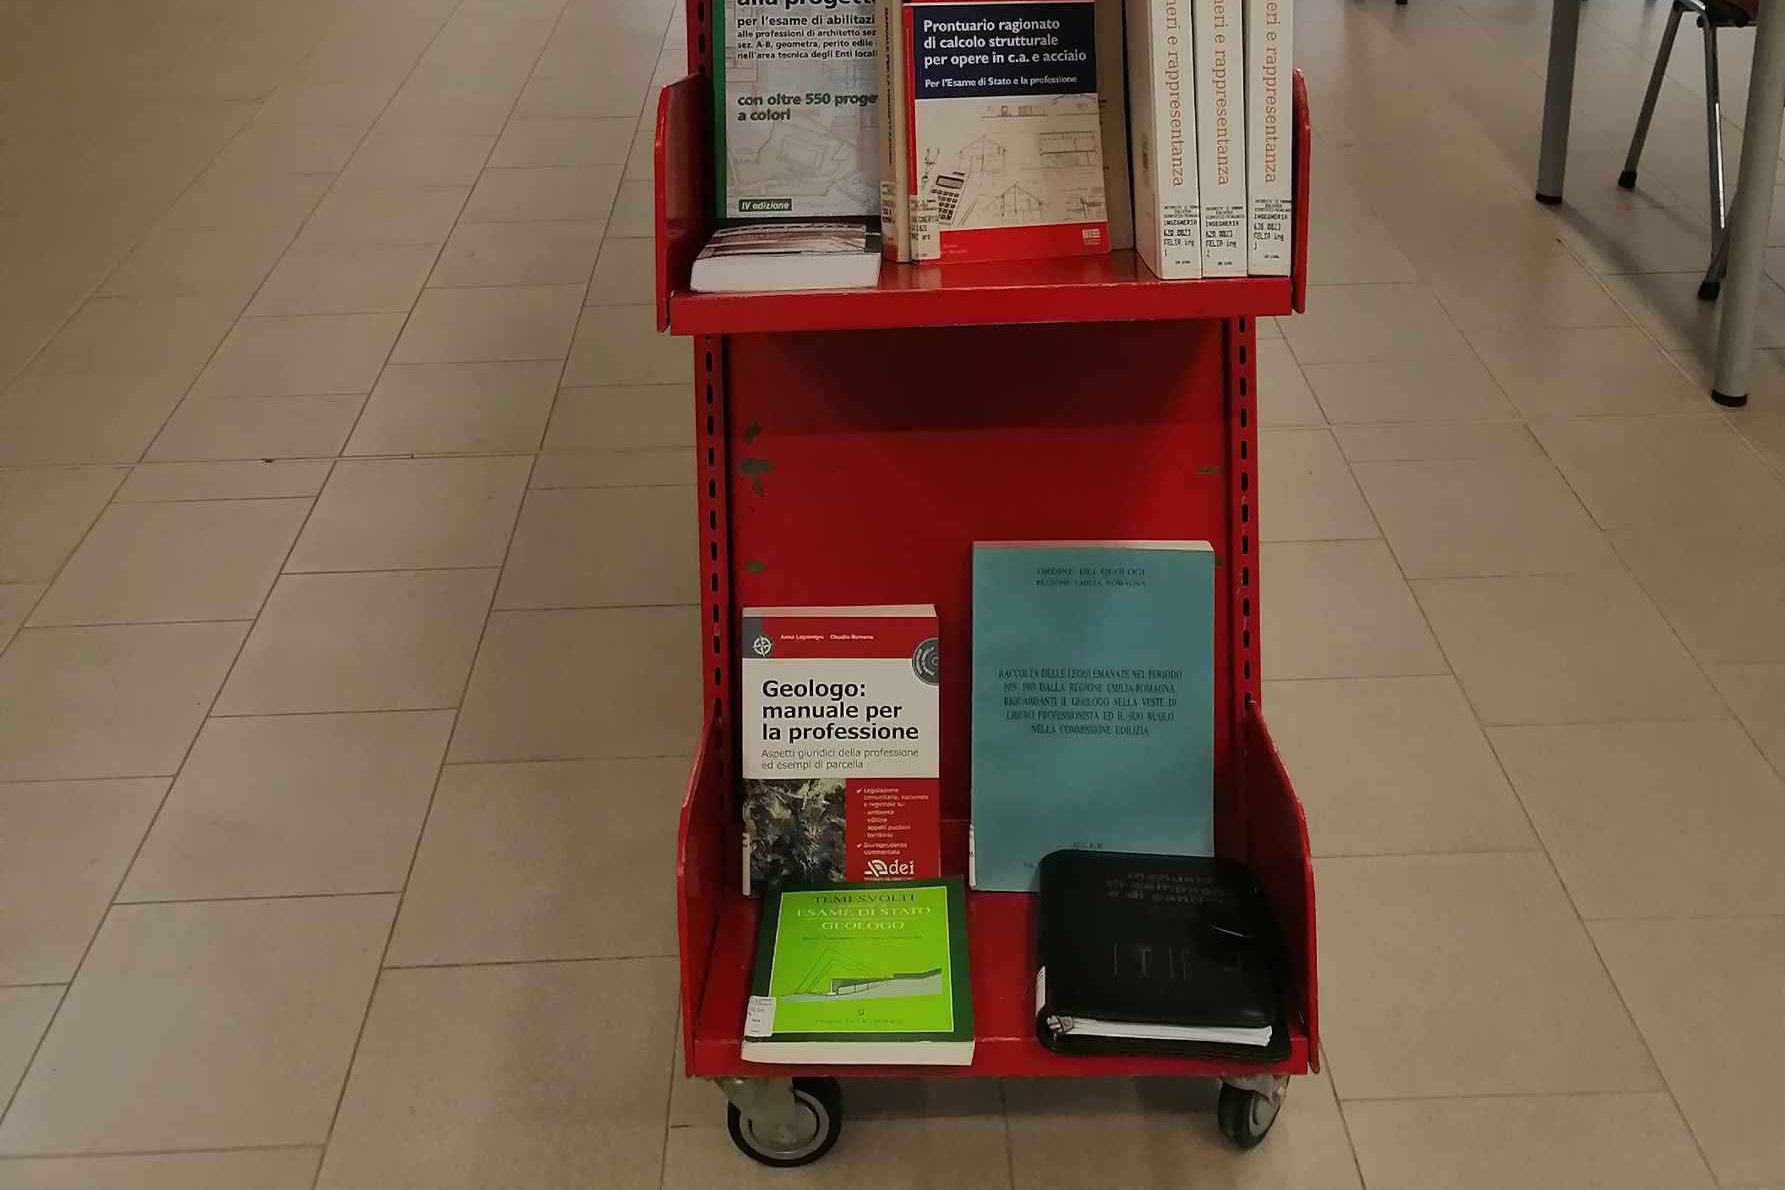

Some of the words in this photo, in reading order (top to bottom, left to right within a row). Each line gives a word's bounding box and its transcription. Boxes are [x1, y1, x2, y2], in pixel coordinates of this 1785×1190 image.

[737, 16, 757, 28] per
[761, 15, 808, 26] l'esame
[811, 14, 823, 25] di
[827, 14, 875, 25] abilitazi
[923, 19, 995, 33] Prontuario
[998, 18, 1060, 35] ragionato
[755, 30, 804, 40] professioni
[807, 29, 815, 37] di
[817, 28, 860, 37] architetto
[1167, 34, 1178, 45] e
[1214, 33, 1226, 44] e
[1266, 31, 1278, 41] e
[823, 40, 850, 51] perito
[851, 39, 873, 48] edile
[923, 36, 936, 49] di
[939, 35, 986, 49] calcolo
[989, 34, 1059, 47] strutturale
[777, 51, 810, 59] tecnica
[811, 50, 833, 60] degli
[835, 50, 852, 59] Enti
[924, 53, 948, 69] per
[950, 53, 989, 68] opere
[992, 51, 1005, 64] in
[1007, 52, 1030, 64] c.a.
[1031, 52, 1040, 63] e
[1043, 48, 1087, 62] acciaio
[924, 78, 940, 88] Per
[941, 78, 976, 88] l'Esame
[978, 77, 987, 87] di
[987, 76, 1011, 86] Stato
[1020, 76, 1029, 85] la
[1030, 75, 1077, 86] professione
[737, 95, 763, 106] con
[767, 92, 801, 106] oltre
[805, 92, 831, 105] 550
[834, 94, 878, 109] proge
[737, 111, 746, 122] a
[750, 108, 791, 121] colori
[1165, 51, 1185, 187] rappresentanza
[1212, 50, 1230, 185] rappresentanza
[1262, 48, 1279, 184] rappresentanza
[741, 200, 751, 210] IV
[752, 200, 789, 210] edizione
[762, 679, 866, 701] Geologo:
[762, 702, 859, 718] manuale
[866, 705, 903, 722] per
[762, 723, 781, 740] la
[789, 723, 919, 743] professione
[762, 749, 795, 760] Aspetti
[798, 748, 835, 760] giuridici
[838, 748, 861, 757] della
[864, 748, 919, 759] professione
[762, 760, 774, 770] ed
[776, 760, 811, 771] esempi
[814, 760, 823, 769] di
[826, 760, 864, 771] parcella
[889, 859, 915, 875] dei
[858, 907, 875, 917] DI
[821, 920, 905, 931] GEOLOGO
